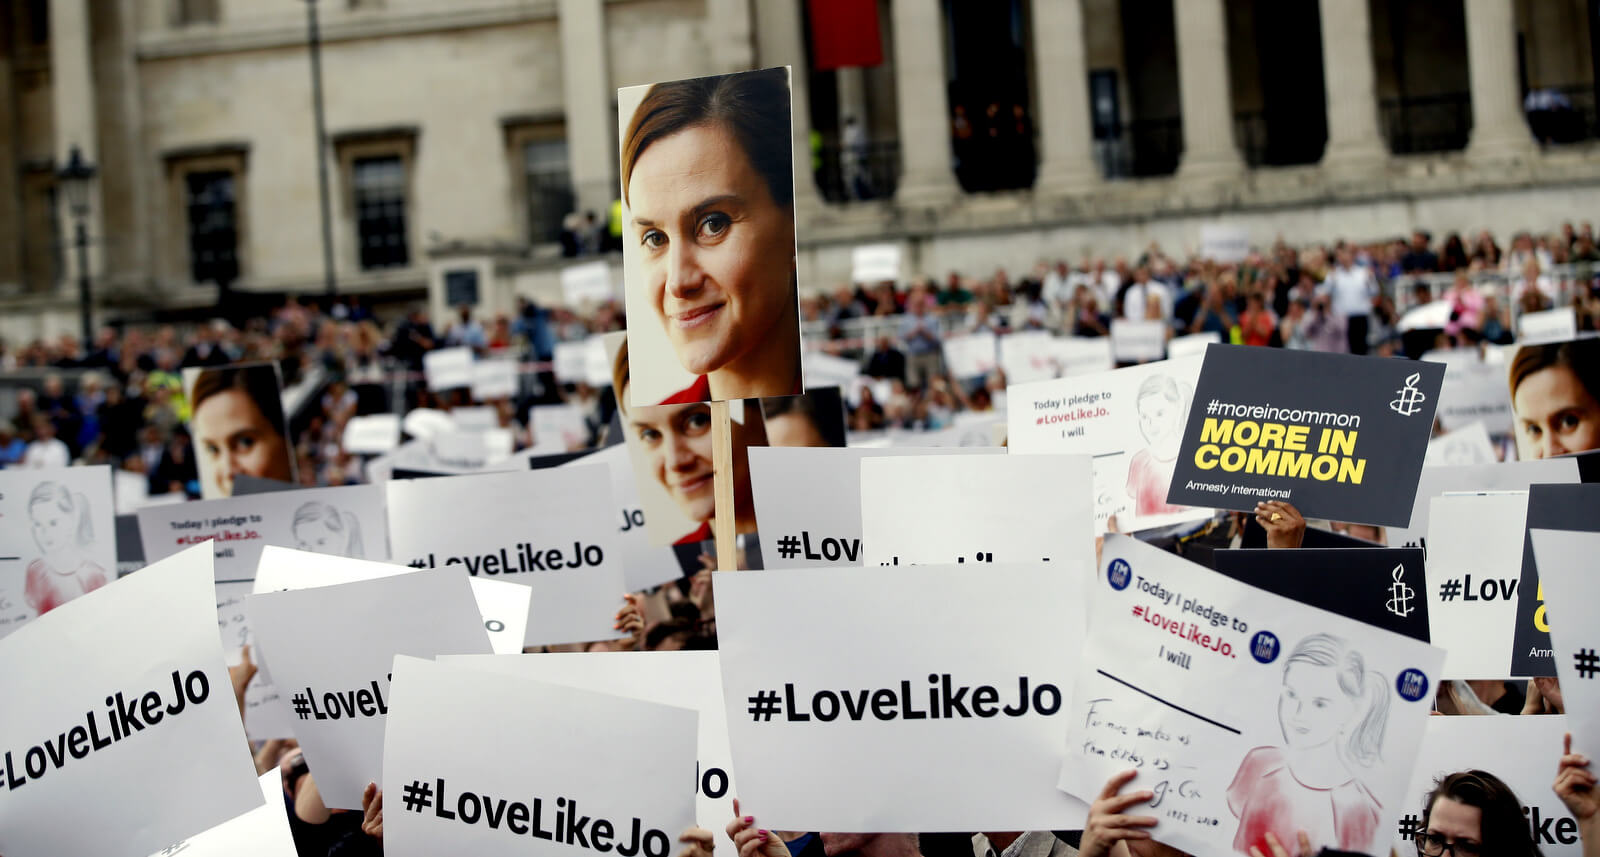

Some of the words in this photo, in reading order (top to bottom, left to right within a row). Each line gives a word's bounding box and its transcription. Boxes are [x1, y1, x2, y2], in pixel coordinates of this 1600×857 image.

[1034, 400, 1060, 411] Today
[1068, 393, 1100, 408] pledge
[1102, 392, 1111, 400] to
[1036, 407, 1110, 426] #LoveLikeJo.
[1207, 399, 1361, 428] #moreincommon
[1067, 427, 1084, 438] will
[1200, 417, 1311, 451] MORE
[1318, 428, 1358, 456] IN
[1194, 444, 1367, 485] COMMON
[1185, 480, 1230, 495] Amnesty
[1231, 484, 1291, 499] International
[1136, 576, 1174, 605] Today
[1182, 598, 1229, 627] pledge
[1233, 617, 1248, 633] to
[1131, 605, 1236, 659] #LoveLikeJo.
[1166, 648, 1192, 670] will
[748, 673, 1062, 722] #LoveLikeJo
[402, 777, 671, 857] #LoveLikeJo
